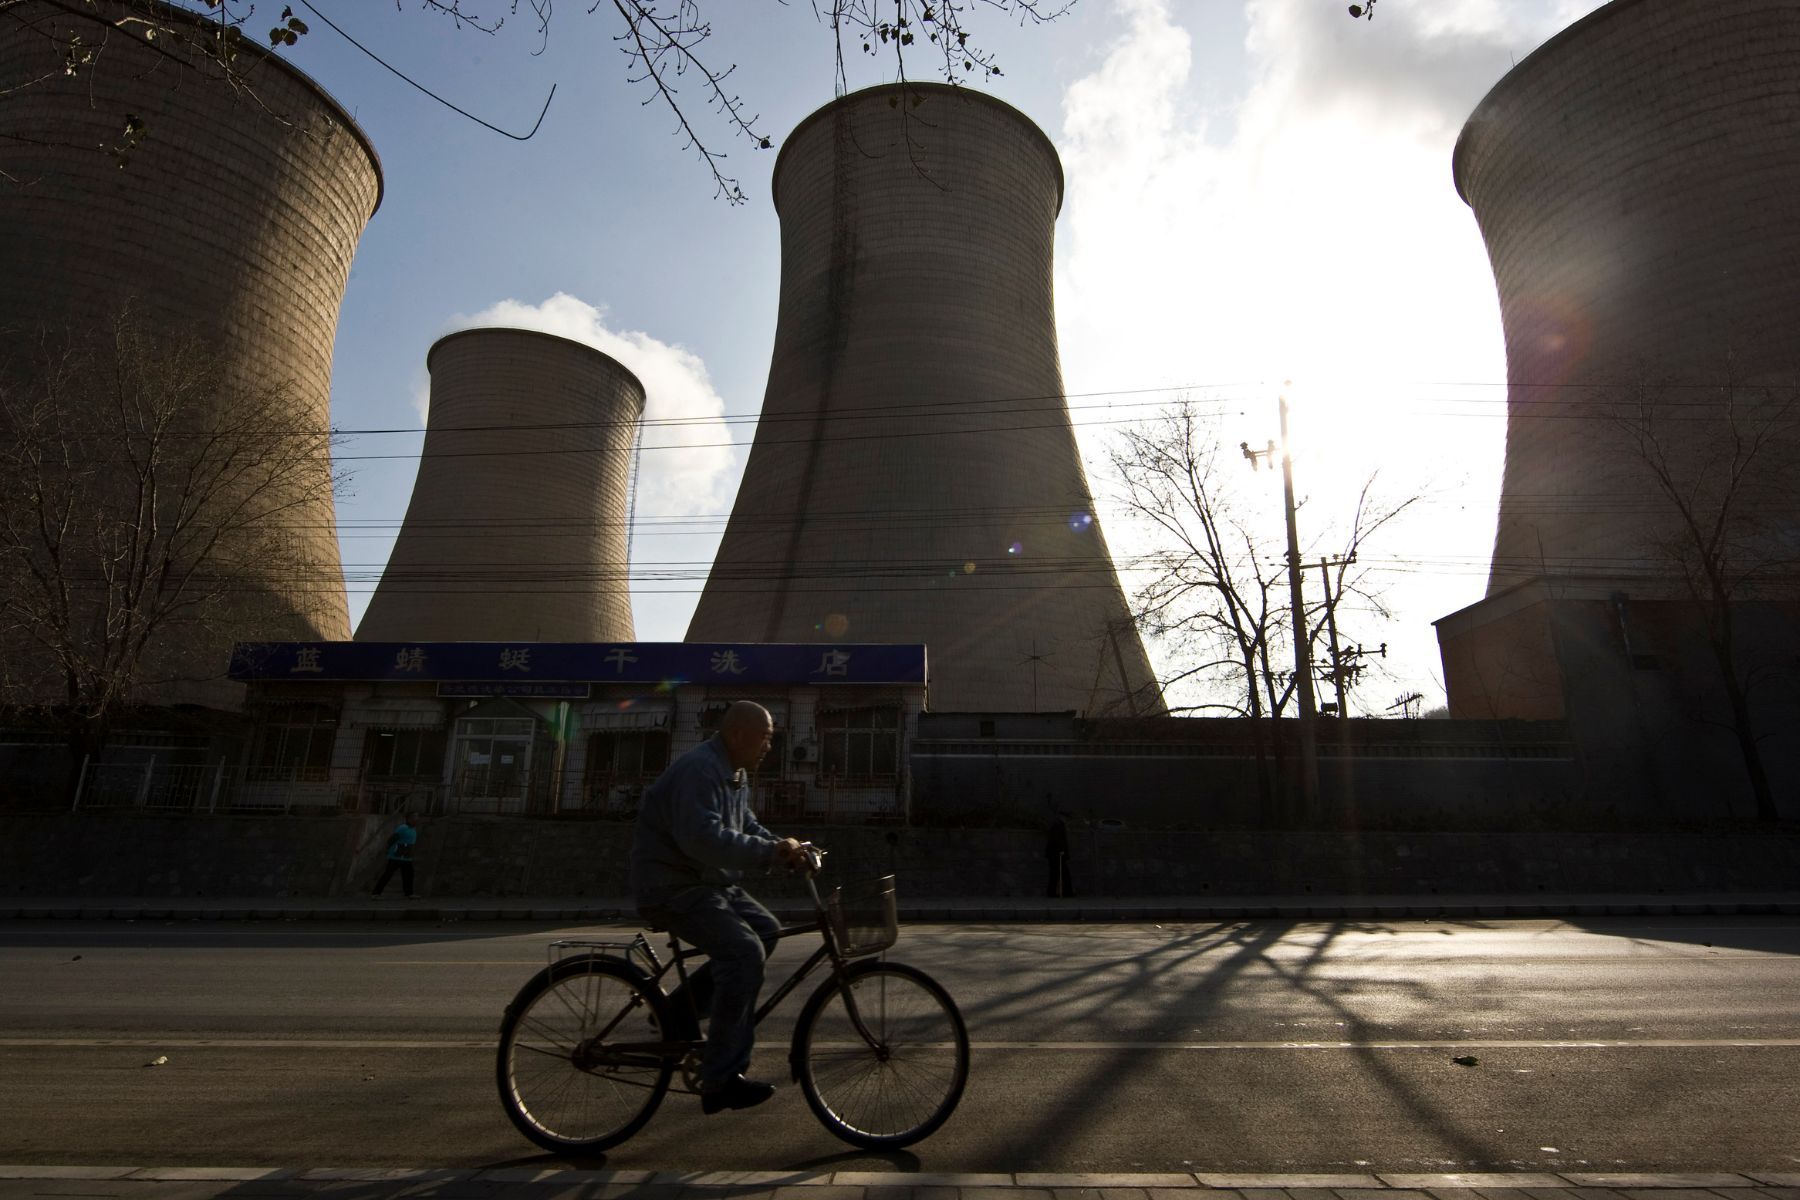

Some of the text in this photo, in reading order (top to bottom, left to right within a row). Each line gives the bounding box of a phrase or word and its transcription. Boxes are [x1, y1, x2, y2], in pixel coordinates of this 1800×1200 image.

[290, 647, 853, 676] 蓝蜻蜓干洗店
